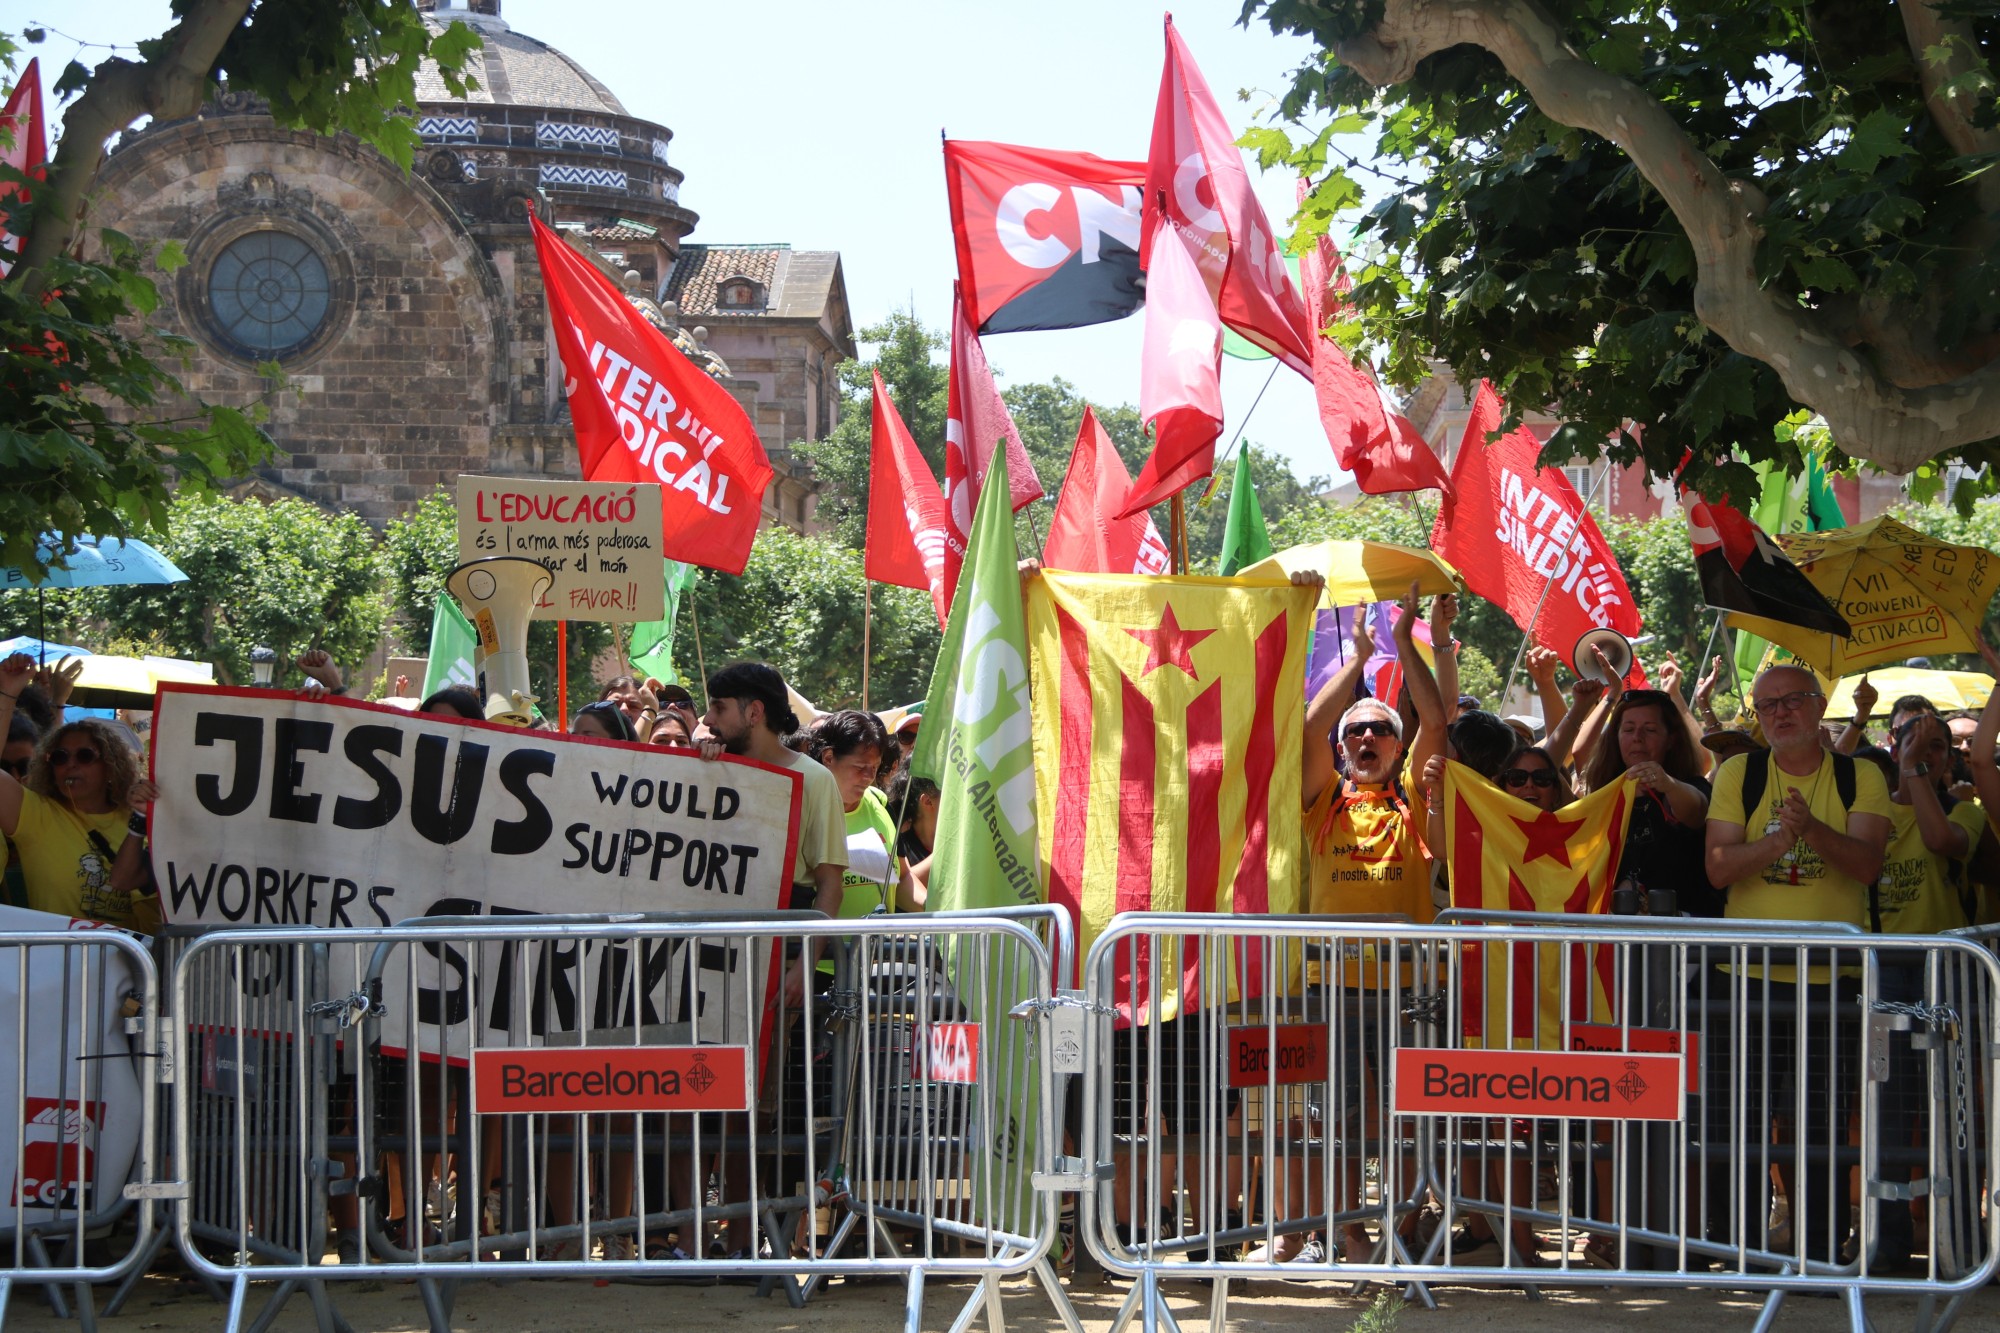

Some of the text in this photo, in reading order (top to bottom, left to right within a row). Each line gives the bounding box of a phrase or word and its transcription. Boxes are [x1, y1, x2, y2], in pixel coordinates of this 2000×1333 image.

[1500, 468, 1592, 564] INTER
[476, 525, 652, 554] és l'arma més poderosa
[574, 553, 587, 573] el
[600, 556, 628, 573] món
[1495, 506, 1613, 628] SINDICA
[535, 582, 638, 611] L FAVOR!!
[1853, 572, 1889, 595] VII
[1846, 595, 1921, 617] CONVENI
[194, 711, 741, 856] JESUS WOULD
[563, 823, 759, 896] SUPPORT
[1331, 867, 1403, 883] el nostre FUTUR
[167, 861, 395, 928] WORKERS
[417, 897, 738, 1044] STRIKE
[1239, 1040, 1305, 1073] Barclona
[502, 1063, 681, 1098] Barcelona
[1424, 1064, 1610, 1103] Barcelona
[20, 1178, 93, 1206] CGT
